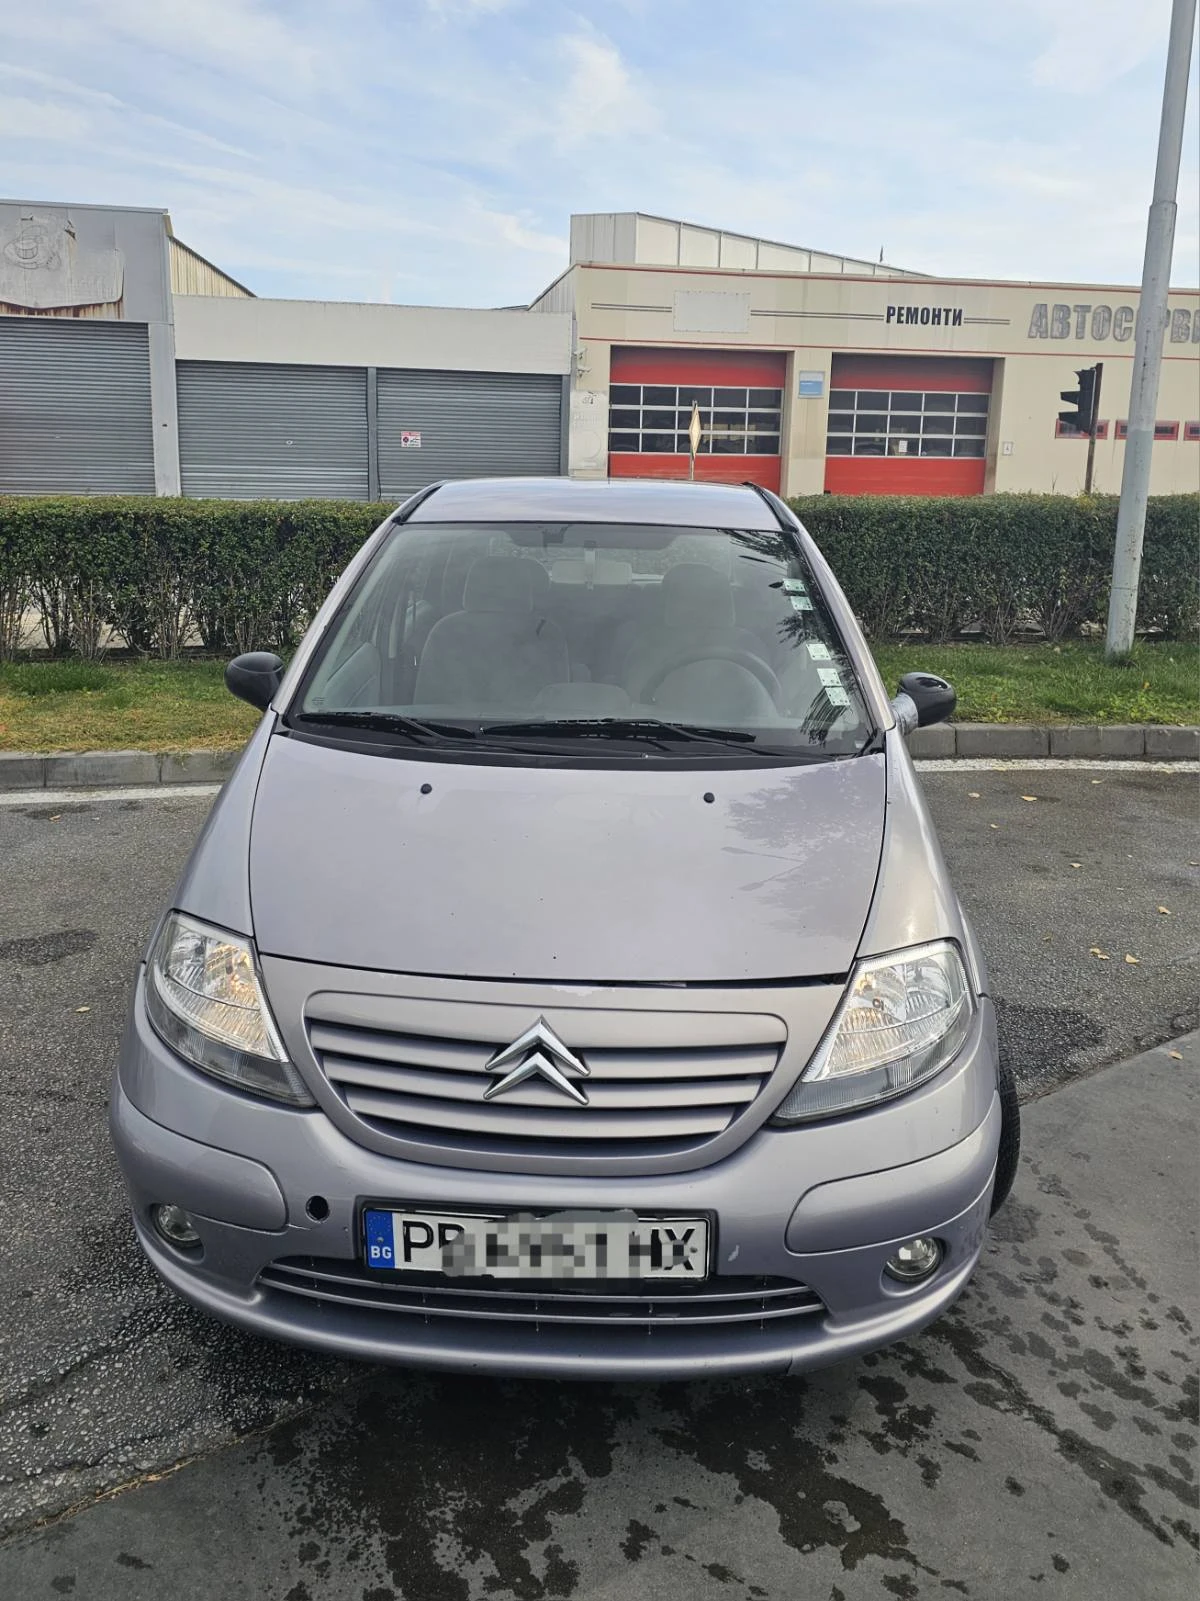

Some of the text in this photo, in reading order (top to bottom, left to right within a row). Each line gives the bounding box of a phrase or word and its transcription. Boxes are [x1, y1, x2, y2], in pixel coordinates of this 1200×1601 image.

[886, 305, 963, 326] РЕМОНТИ
[1027, 303, 1200, 344] АВТОСВ
[370, 1245, 392, 1259] BG
